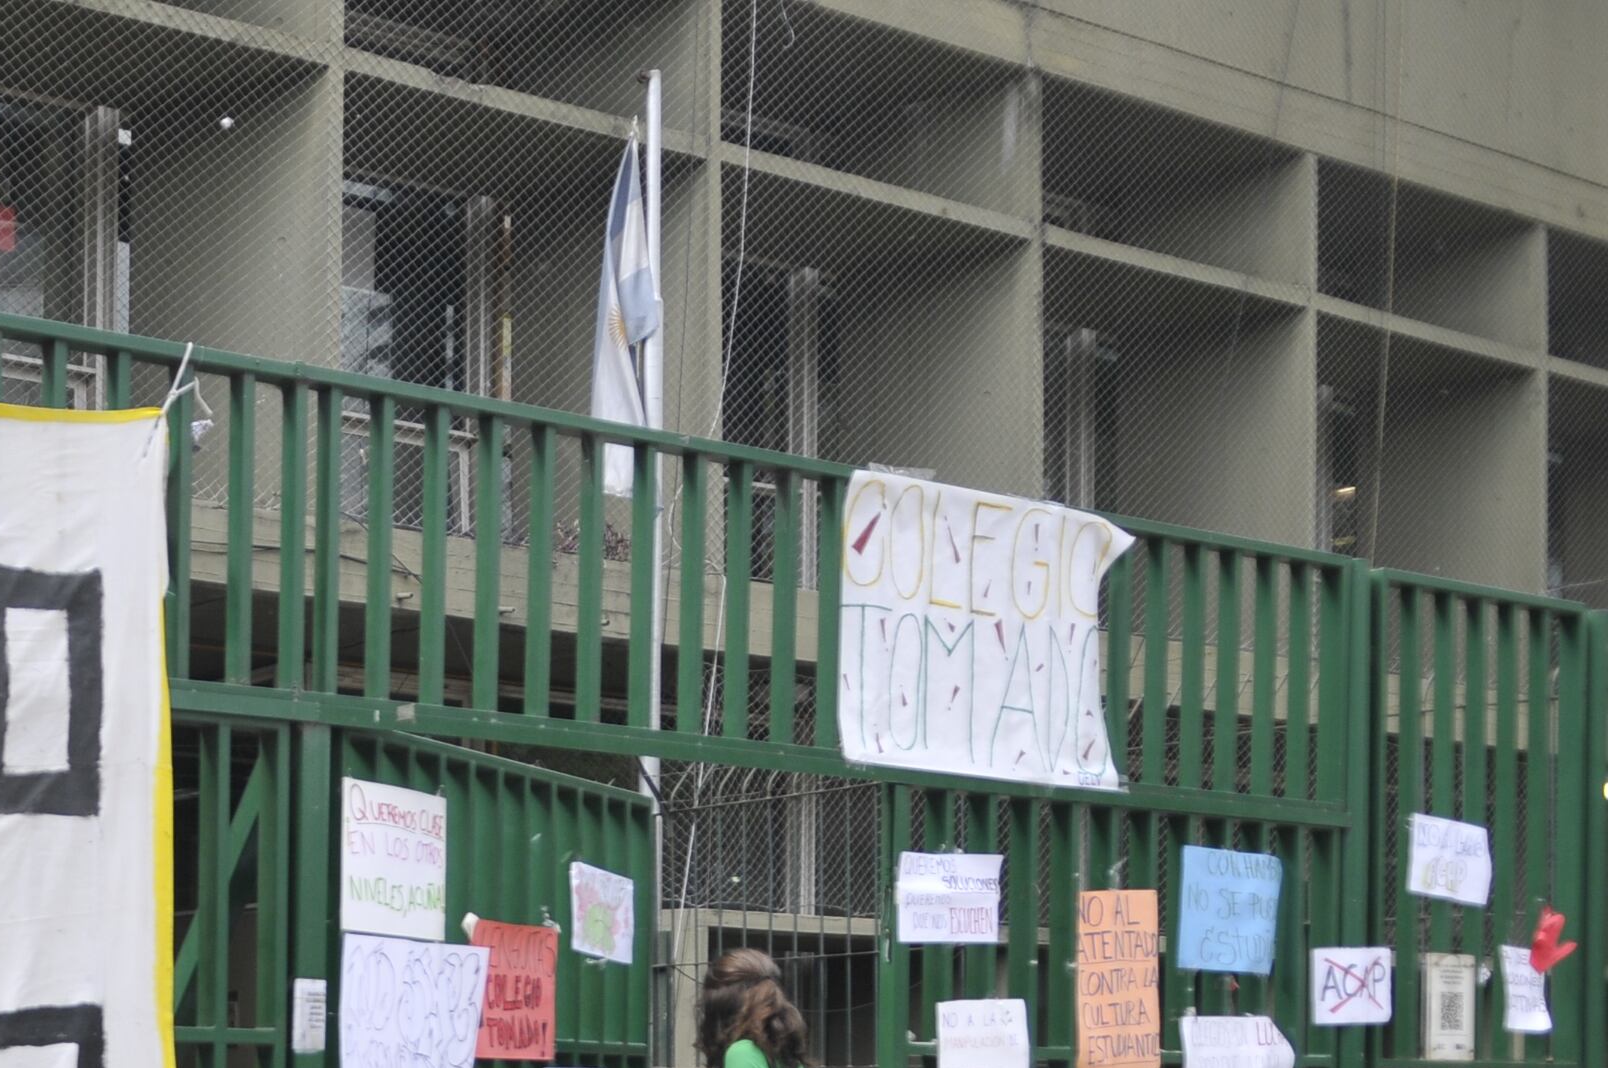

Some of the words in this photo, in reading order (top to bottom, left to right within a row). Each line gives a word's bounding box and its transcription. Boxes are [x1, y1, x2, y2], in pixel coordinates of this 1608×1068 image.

[845, 479, 1112, 620] COLEGIO
[841, 603, 1108, 776] TOMADO
[350, 783, 417, 831] QUEREMOS
[348, 830, 375, 855] EN
[385, 832, 409, 861] LOS
[905, 855, 956, 876] QUEREMOS
[942, 875, 999, 891] SOLUCIONES
[1079, 895, 1104, 927] NO
[1114, 895, 1140, 926] AL
[1187, 881, 1209, 912] NO
[1217, 888, 1242, 920] SE
[1248, 892, 1277, 921] PUE
[950, 907, 993, 934] ESCUCHEN
[487, 974, 542, 1010] COLEGIO
[1080, 967, 1138, 997] CONTRA
[1143, 966, 1159, 989] LA
[1083, 998, 1152, 1029] CULTURA
